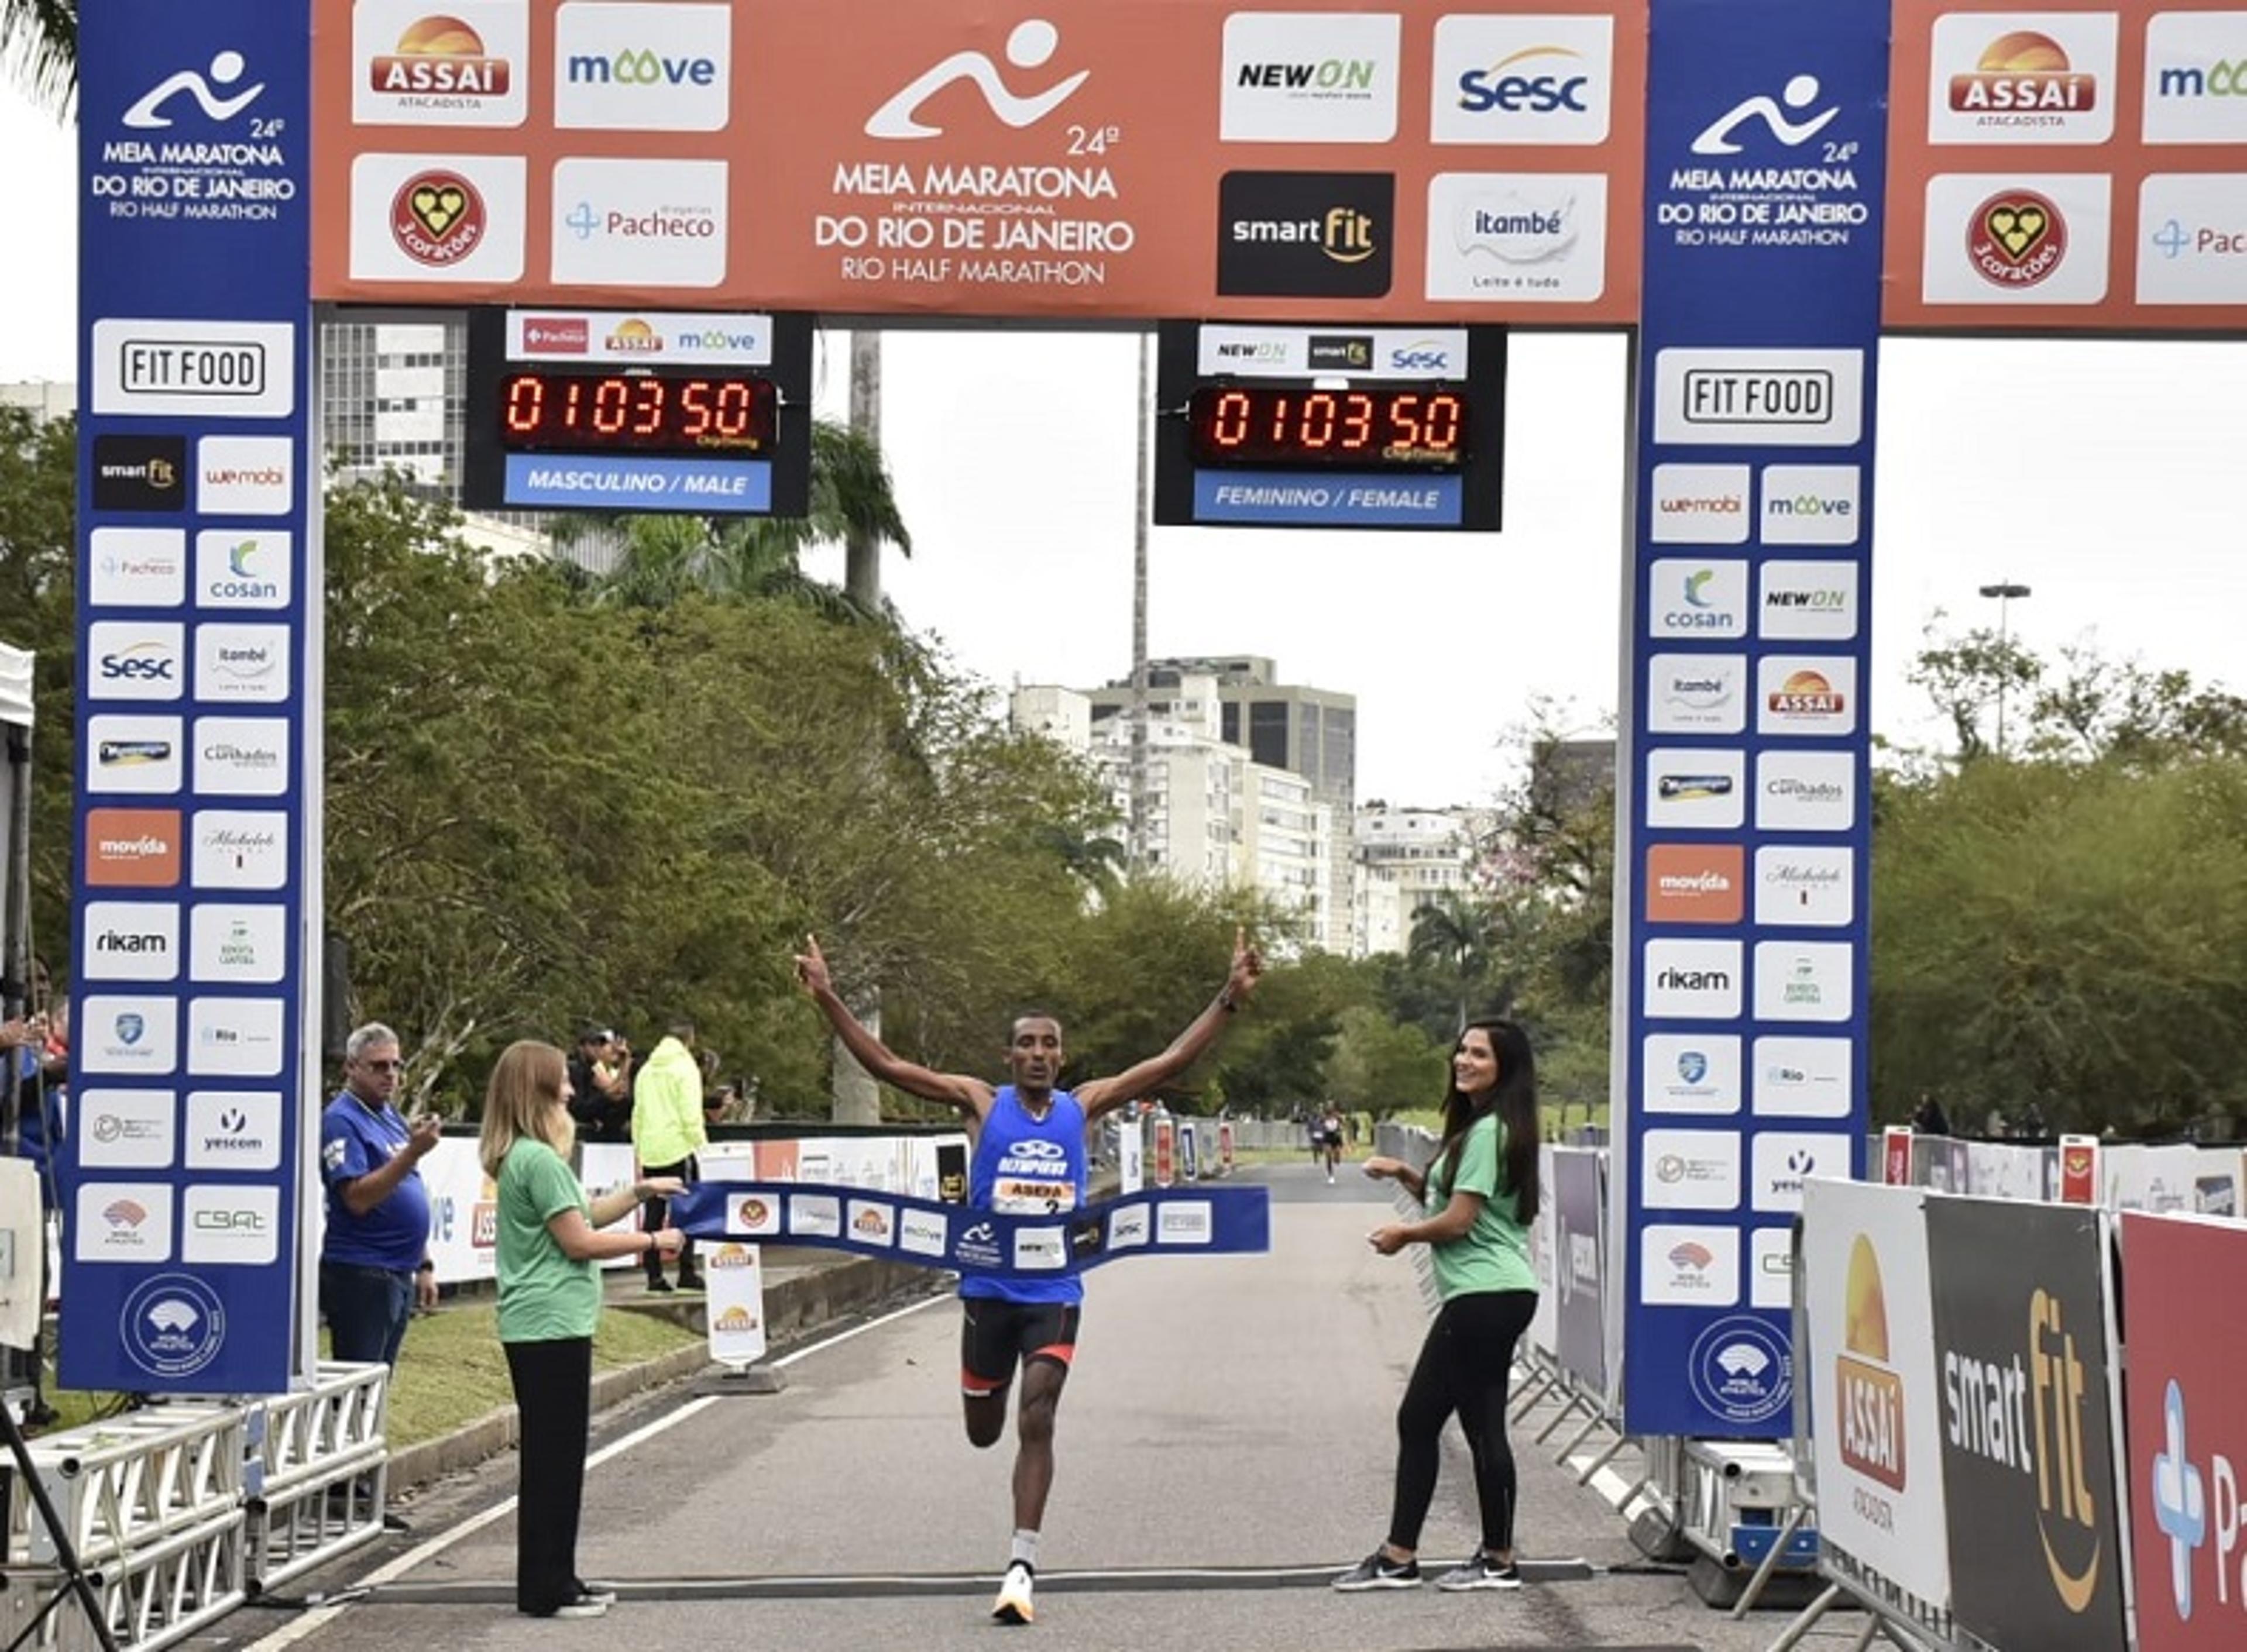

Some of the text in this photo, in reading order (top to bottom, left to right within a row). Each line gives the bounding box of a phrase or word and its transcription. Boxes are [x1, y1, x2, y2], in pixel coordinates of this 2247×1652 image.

[398, 97, 481, 109] ATACADISTA
[1977, 116, 2065, 126] ATACADISTA
[103, 142, 284, 166] MEIA MARATONA
[94, 176, 295, 199] DO RIO DE JANEIRO
[833, 163, 1118, 199] MEIA MARATONA
[1669, 170, 1857, 190] MEIA MARATONA
[111, 201, 277, 220] RIO HALF MARATHON
[893, 202, 1055, 215] INTERNACIONAL
[1658, 203, 1868, 224] DO RIO DE JANEIRO
[607, 211, 714, 237] Pacheco
[816, 216, 1135, 252] DO RIO DE JANEIRO
[1676, 230, 1849, 245] RIO HALF MARATHON
[841, 257, 1105, 284] RIO HALF MARATHON
[133, 350, 254, 386] FIT FOOD
[1695, 379, 1821, 414] FIT FOOD
[528, 470, 665, 491] MASCULINO
[685, 474, 748, 494] MALE
[1215, 486, 1329, 507] FEMININO
[1347, 490, 1439, 508] FEMALE
[210, 582, 276, 598] cosan
[1665, 611, 1733, 627] cosan
[97, 930, 166, 952] rikam
[1658, 966, 1729, 990] rikam
[205, 1137, 262, 1151] yescom
[1945, 1289, 2094, 1527] smart fit
